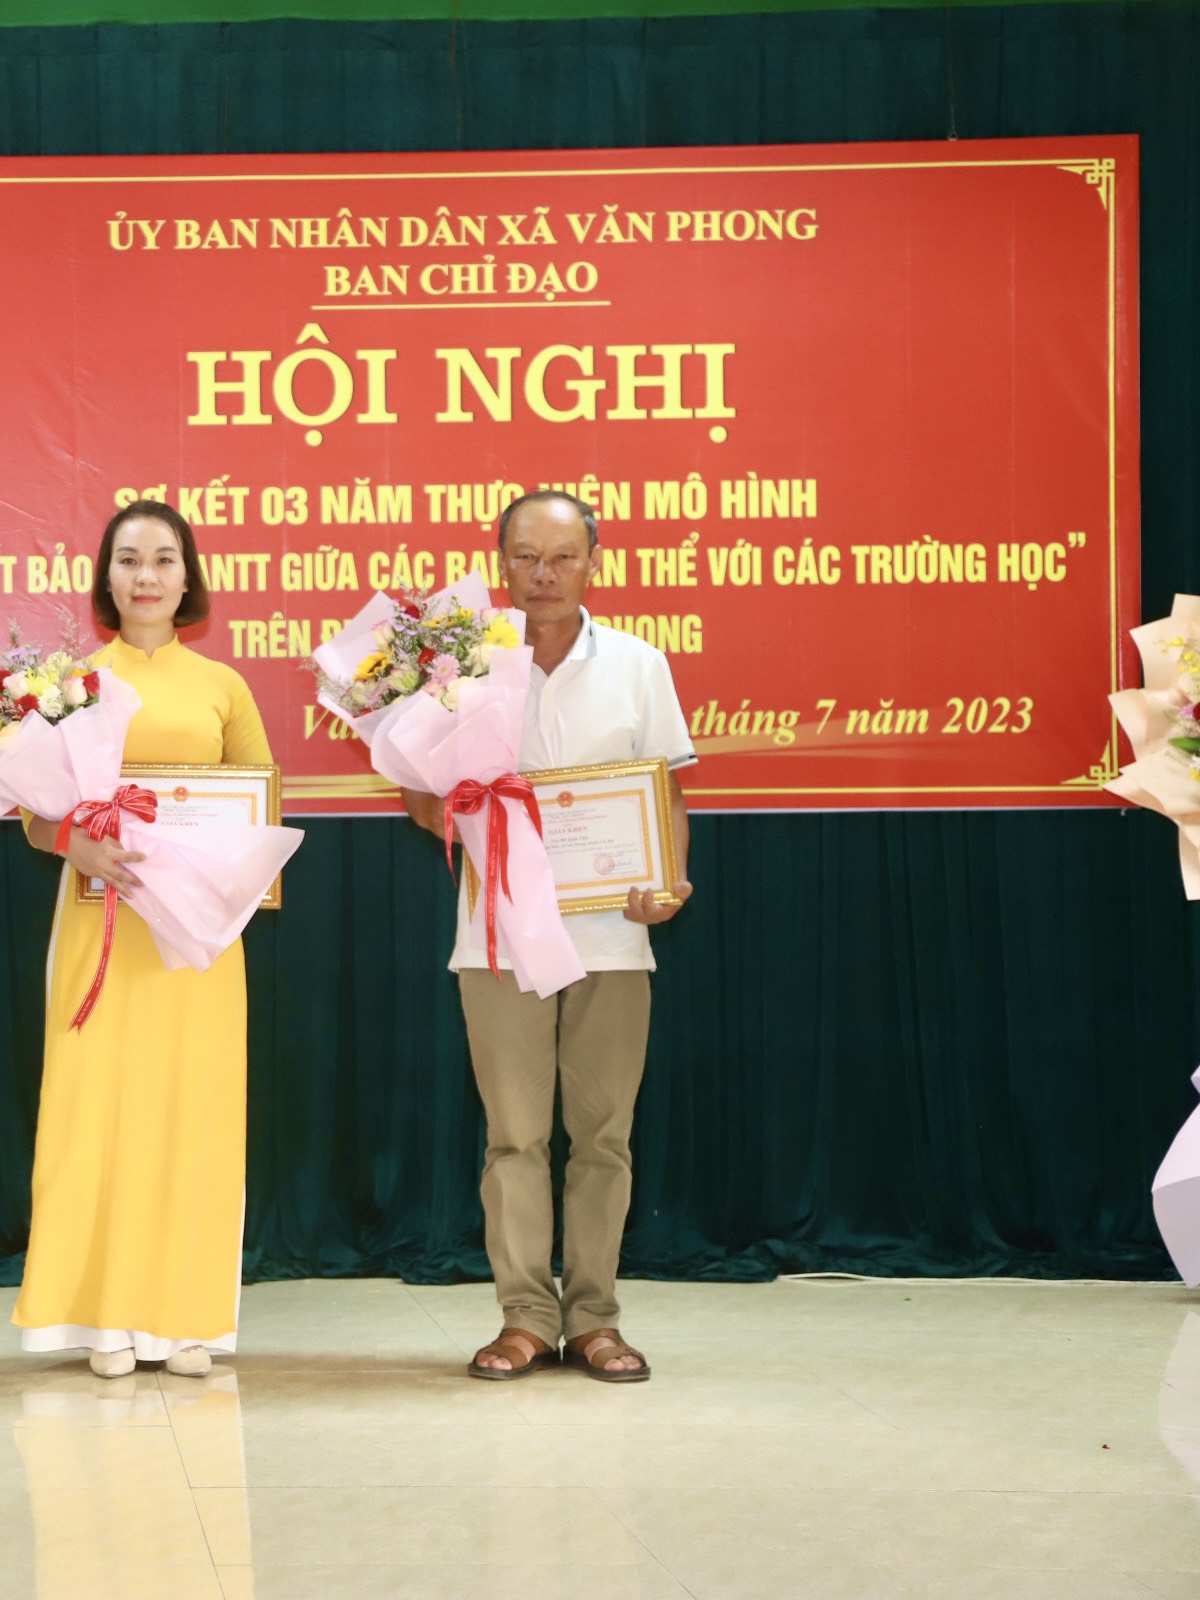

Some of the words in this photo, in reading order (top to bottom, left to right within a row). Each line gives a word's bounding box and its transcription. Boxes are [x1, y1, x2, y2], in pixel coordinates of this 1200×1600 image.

[107, 210, 166, 251] ỦY
[174, 218, 260, 250] BAN
[269, 207, 389, 249] NHÂN
[399, 205, 488, 247] DÂN
[497, 206, 558, 246] XÃ
[565, 204, 656, 244] VĂN
[666, 208, 819, 242] PHONG
[323, 264, 410, 297] BAN
[419, 253, 498, 296] CHỈ
[506, 261, 599, 302] ĐẠO
[186, 322, 398, 447] HỘI
[434, 342, 736, 444] NGHỊ
[178, 473, 250, 526] KẾT
[260, 485, 309, 526] 03
[319, 476, 413, 525] NĂM
[643, 471, 708, 521] MÔ
[720, 471, 818, 519] HÌNH
[27, 542, 92, 593] BẢO
[281, 544, 359, 592] GIỮA
[369, 544, 435, 591] CÁC
[635, 531, 700, 587] THỂ
[706, 538, 763, 587] VỚI
[772, 537, 841, 586] CÁC
[850, 534, 987, 585] TRƯỜNG
[229, 612, 311, 659] TRÊN
[690, 699, 800, 746] tháng
[815, 699, 837, 735] 7
[845, 699, 929, 735] năm
[941, 696, 1034, 734] 2023
